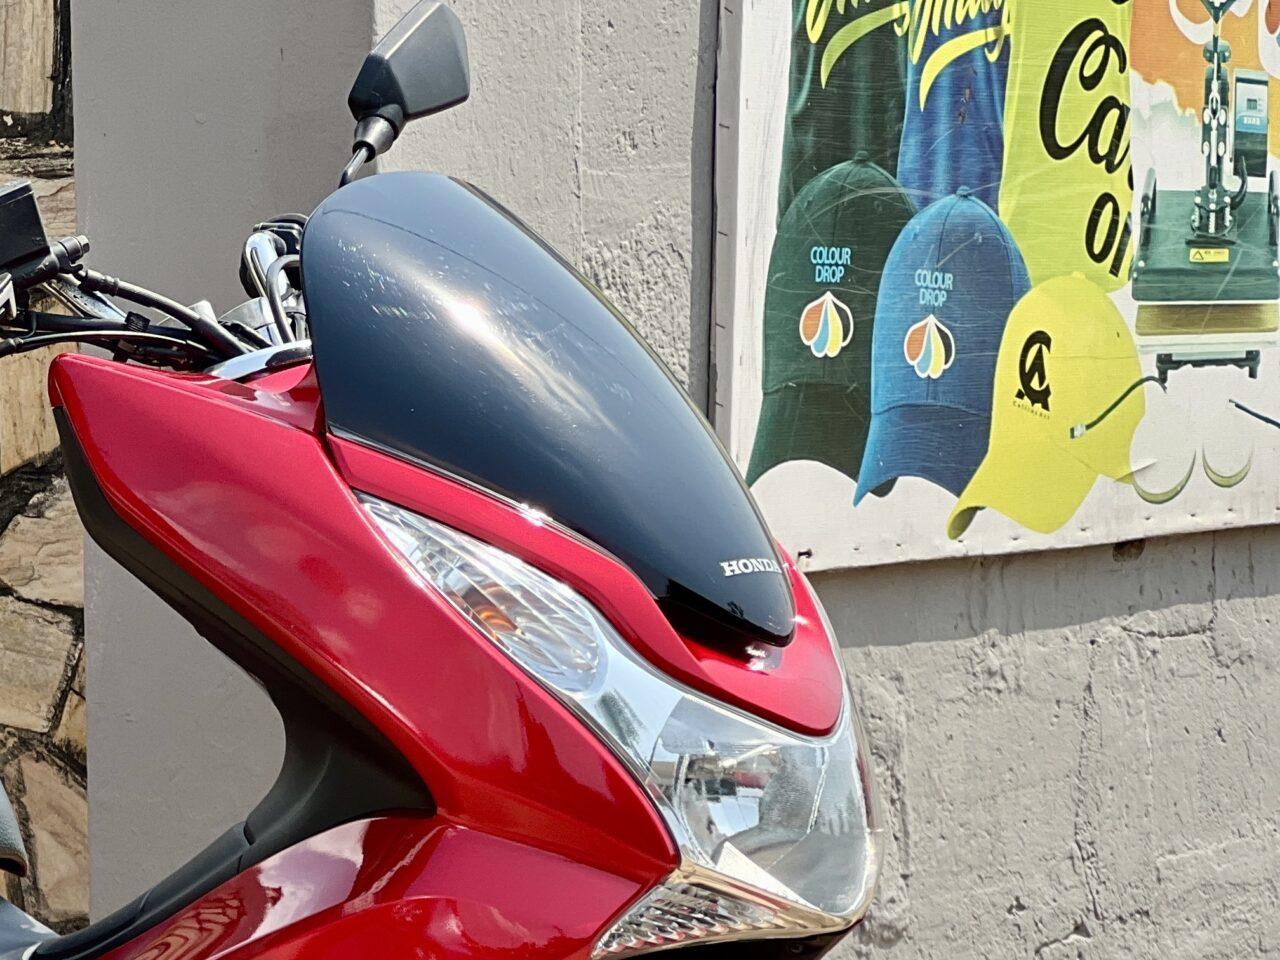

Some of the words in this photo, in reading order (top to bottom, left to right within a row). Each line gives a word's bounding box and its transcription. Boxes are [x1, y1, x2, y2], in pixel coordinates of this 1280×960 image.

[811, 246, 851, 265] COLOUR
[815, 265, 844, 283] DROP
[915, 268, 953, 290] COLOUR
[919, 289, 947, 307] DROP
[720, 559, 783, 577] HONDA
